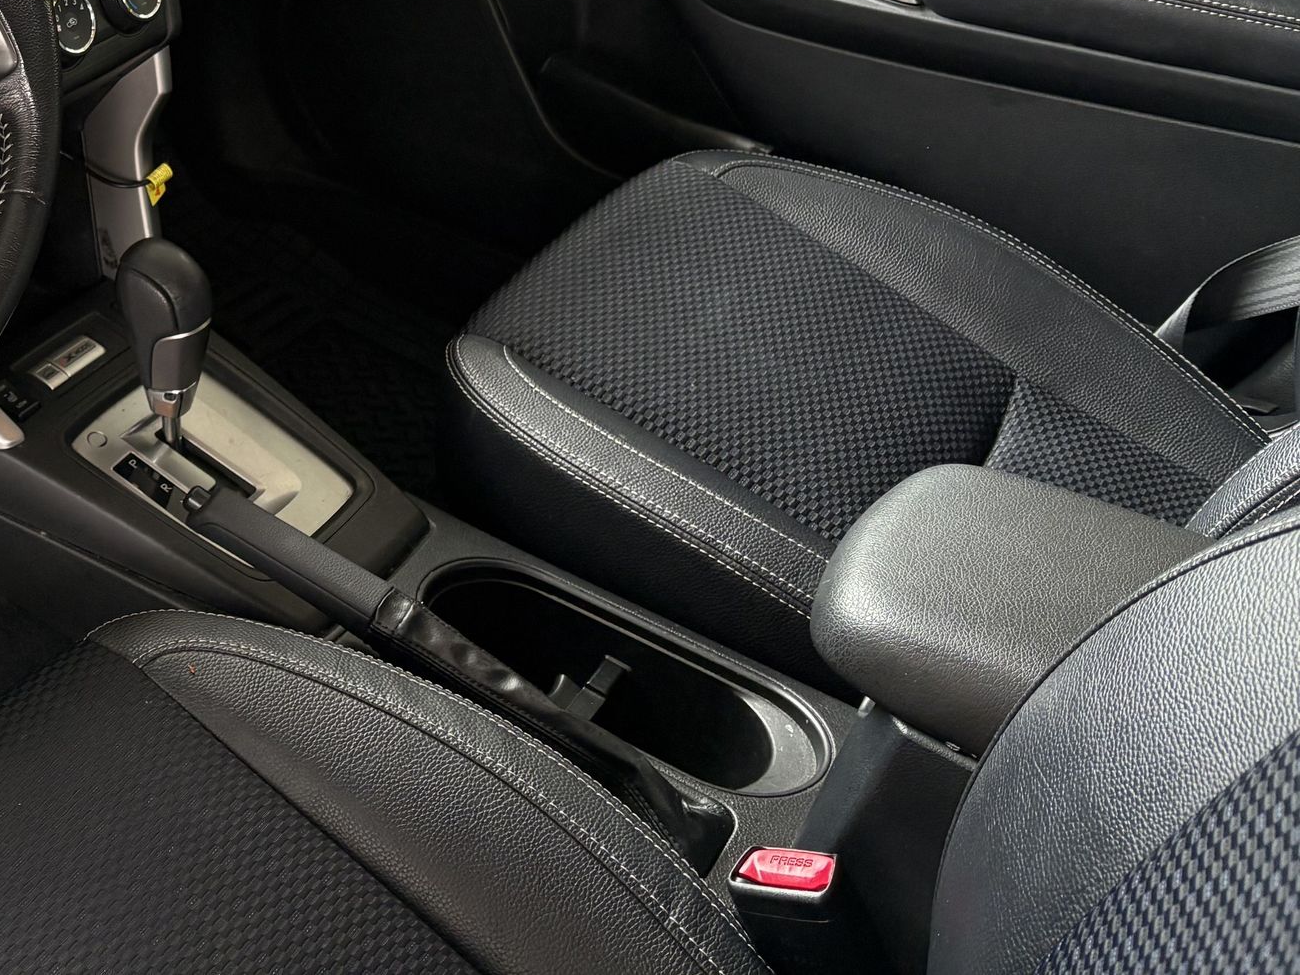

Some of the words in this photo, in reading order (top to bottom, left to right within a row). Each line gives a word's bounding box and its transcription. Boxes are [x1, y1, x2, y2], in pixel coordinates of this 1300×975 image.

[128, 459, 137, 469] P
[160, 483, 173, 493] R
[769, 855, 814, 868] PRESS
